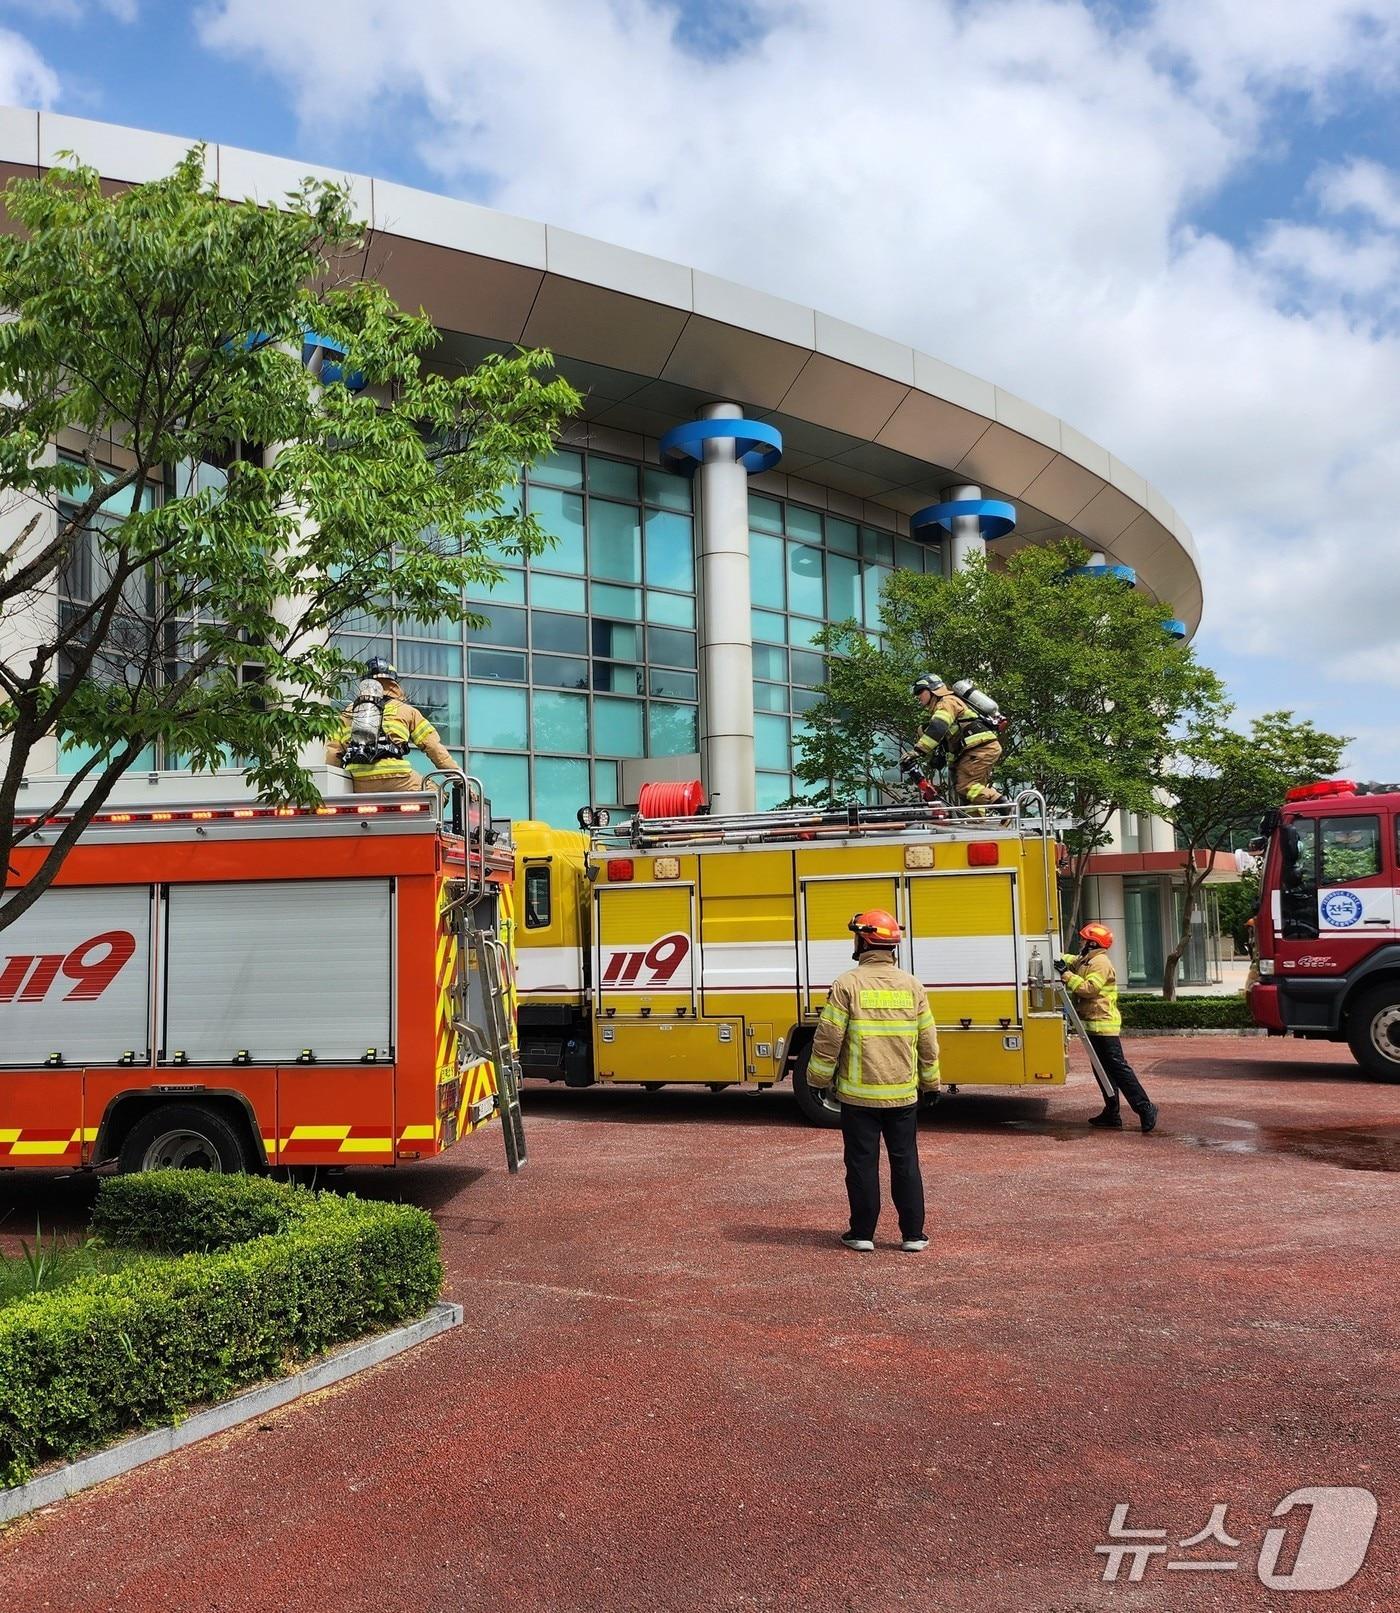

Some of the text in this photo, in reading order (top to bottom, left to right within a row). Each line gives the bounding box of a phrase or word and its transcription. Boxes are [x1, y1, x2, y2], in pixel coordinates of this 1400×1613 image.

[1329, 901, 1355, 915] 전북
[0, 930, 136, 1003] 119
[600, 934, 690, 987] 119
